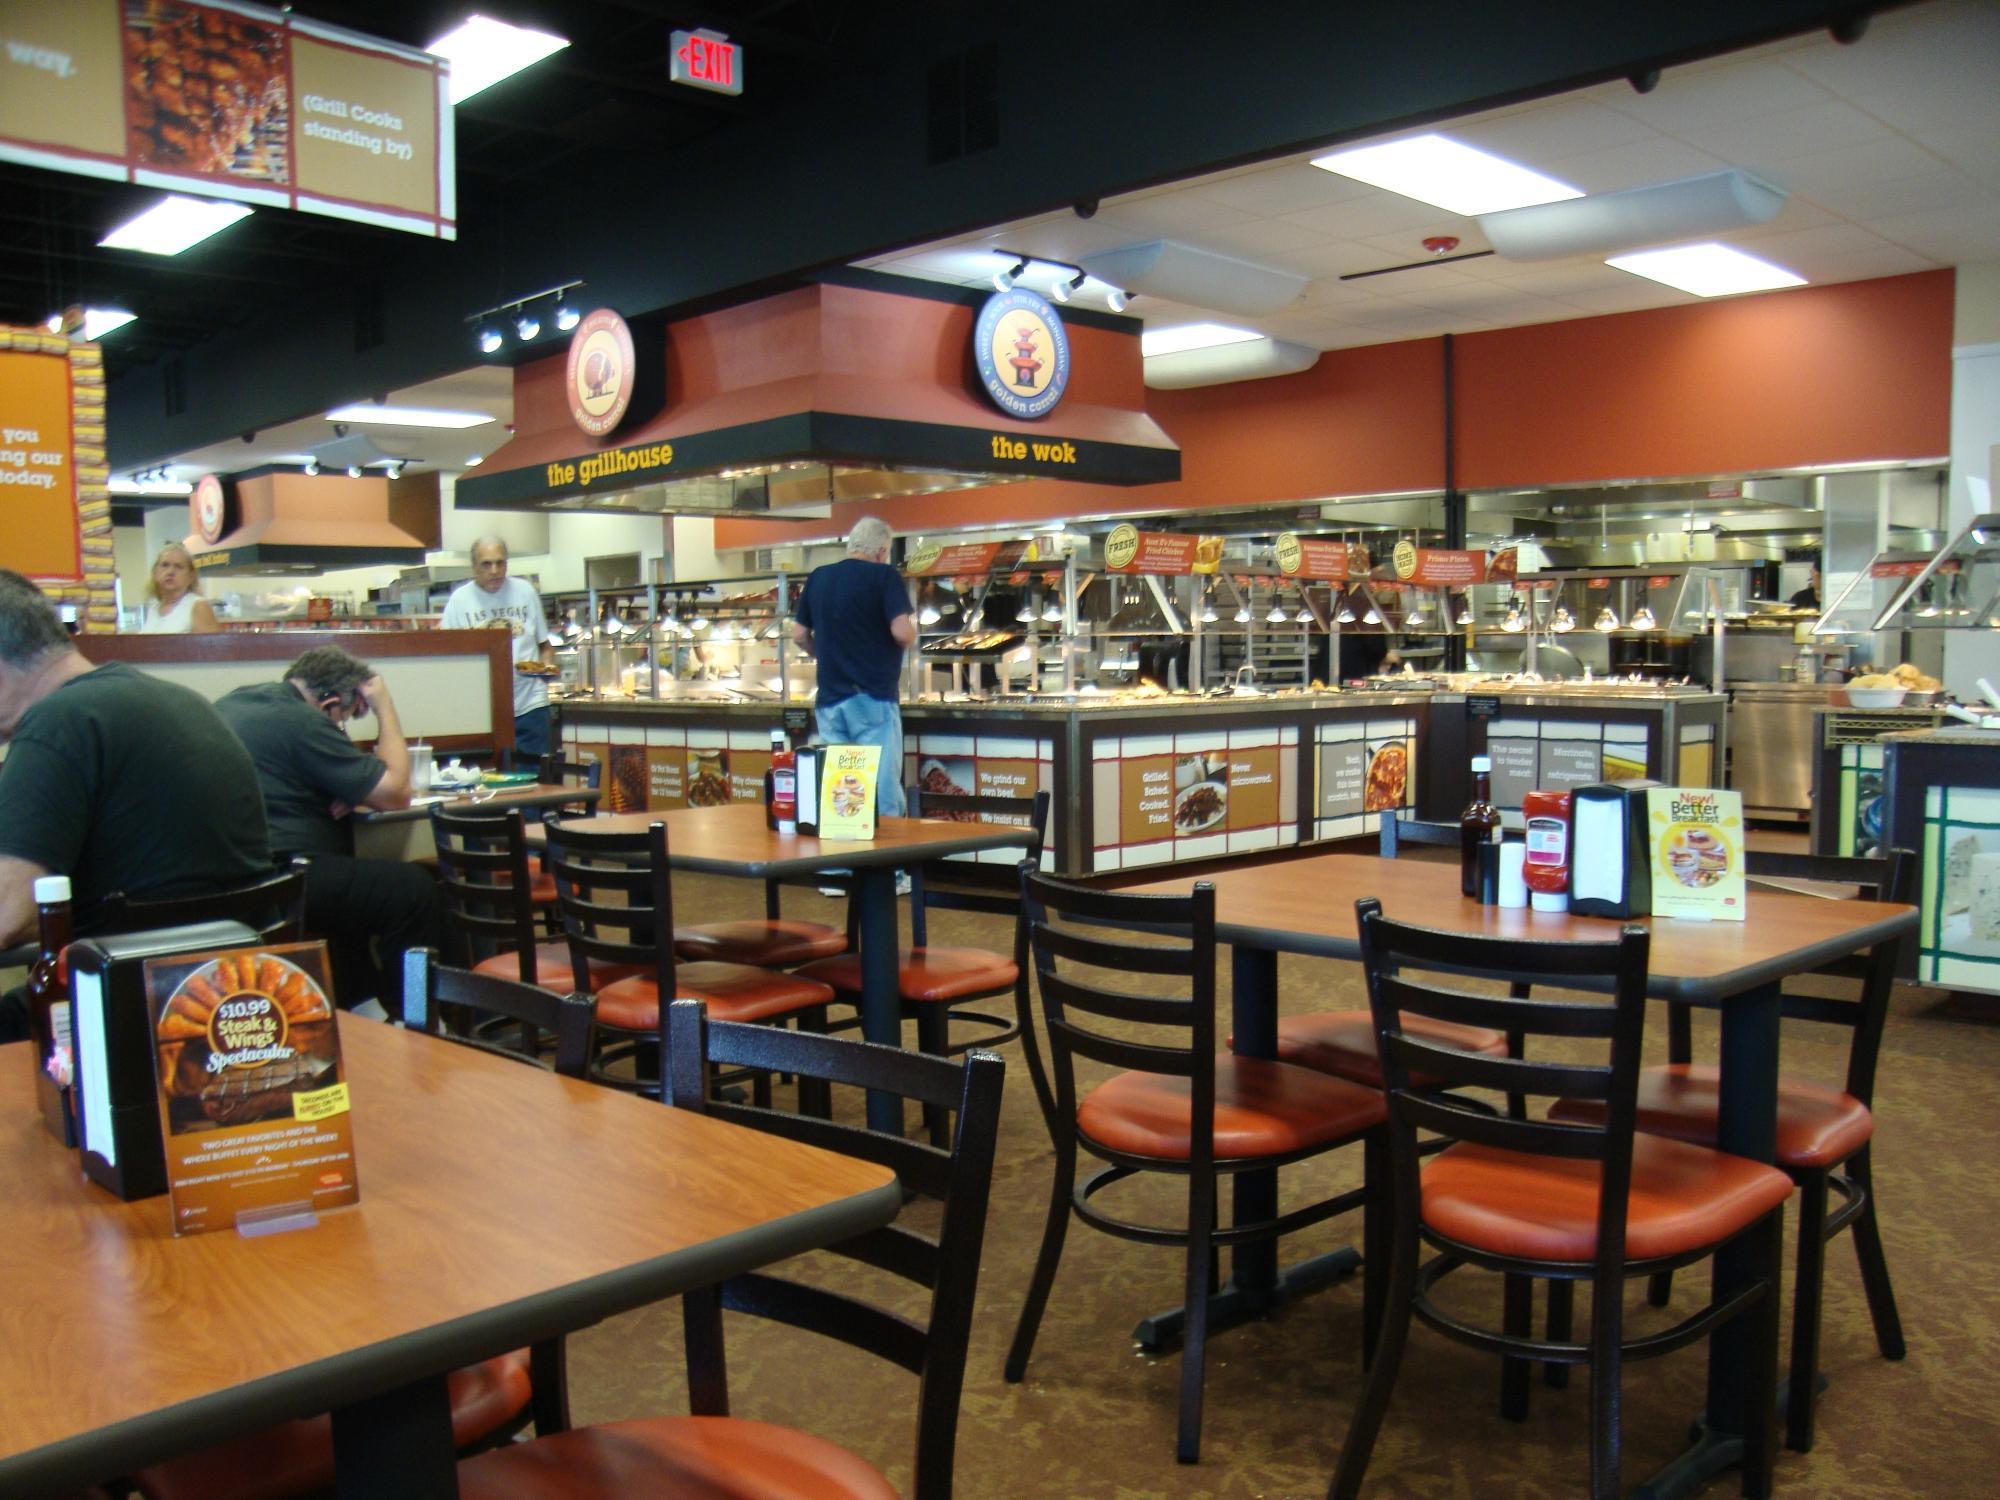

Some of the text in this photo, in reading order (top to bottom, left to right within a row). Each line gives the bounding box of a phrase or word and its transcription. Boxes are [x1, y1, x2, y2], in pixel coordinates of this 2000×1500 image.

[7, 40, 77, 78] way.
[688, 36, 734, 86] EXIT
[303, 94, 402, 130] (Grill Cooks
[303, 121, 412, 160] standing by)
[990, 379, 1058, 413] golden corral
[2, 428, 40, 444] you
[992, 436, 1076, 464] the wok
[31, 453, 64, 466] our
[547, 444, 673, 487] the grillhouse
[1108, 538, 1136, 554] FRESH
[1279, 545, 1299, 560] FRESH
[839, 755, 866, 765] Better
[981, 773, 1026, 785] We grind our
[1680, 792, 1714, 803] New!
[1671, 801, 1719, 815] Better
[1671, 814, 1719, 823] Breakfast
[219, 999, 271, 1019] $10.99
[218, 1016, 278, 1036] Steak &
[224, 1033, 274, 1049] Wings
[206, 1044, 296, 1074] Spectacular
